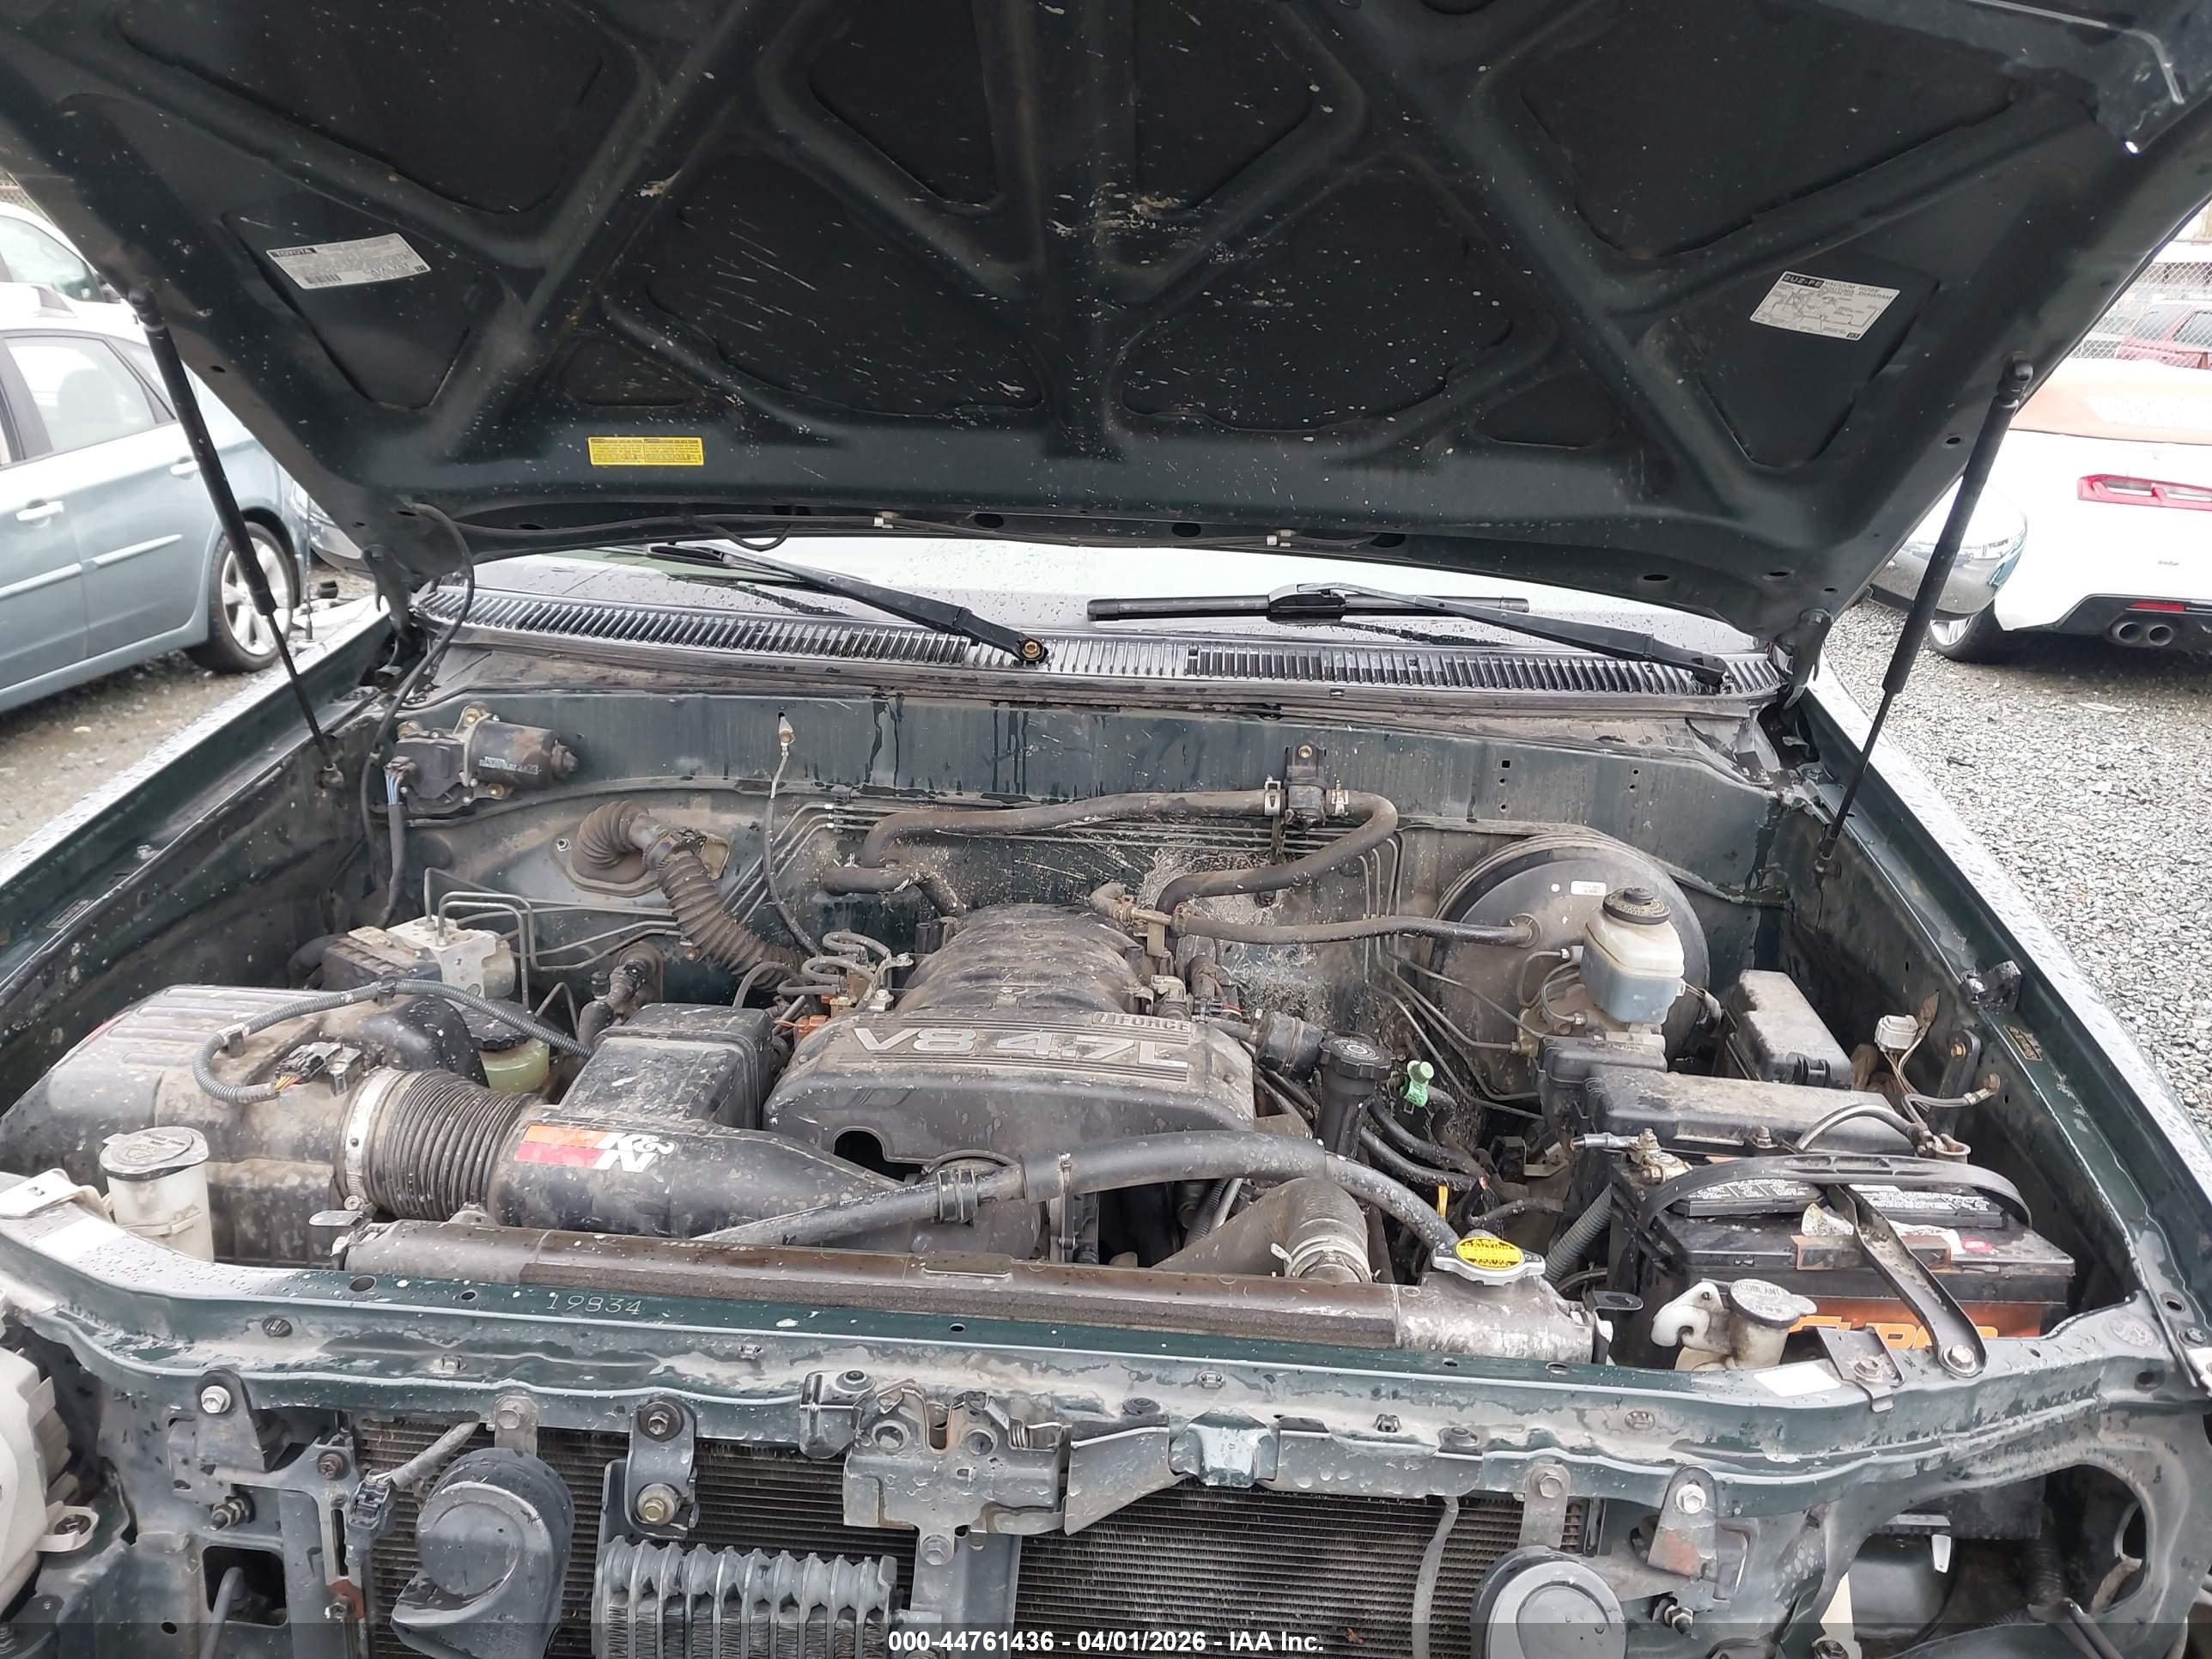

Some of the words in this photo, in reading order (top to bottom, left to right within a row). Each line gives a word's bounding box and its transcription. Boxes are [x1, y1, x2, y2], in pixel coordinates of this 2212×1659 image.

[274, 248, 313, 257] TOYOTA
[1119, 1015, 1191, 1033] FORCE
[853, 1027, 977, 1053] V8
[997, 1030, 1188, 1070] 4.7L
[1738, 1281, 1781, 1296] COOLANT
[545, 1291, 642, 1315] 19834
